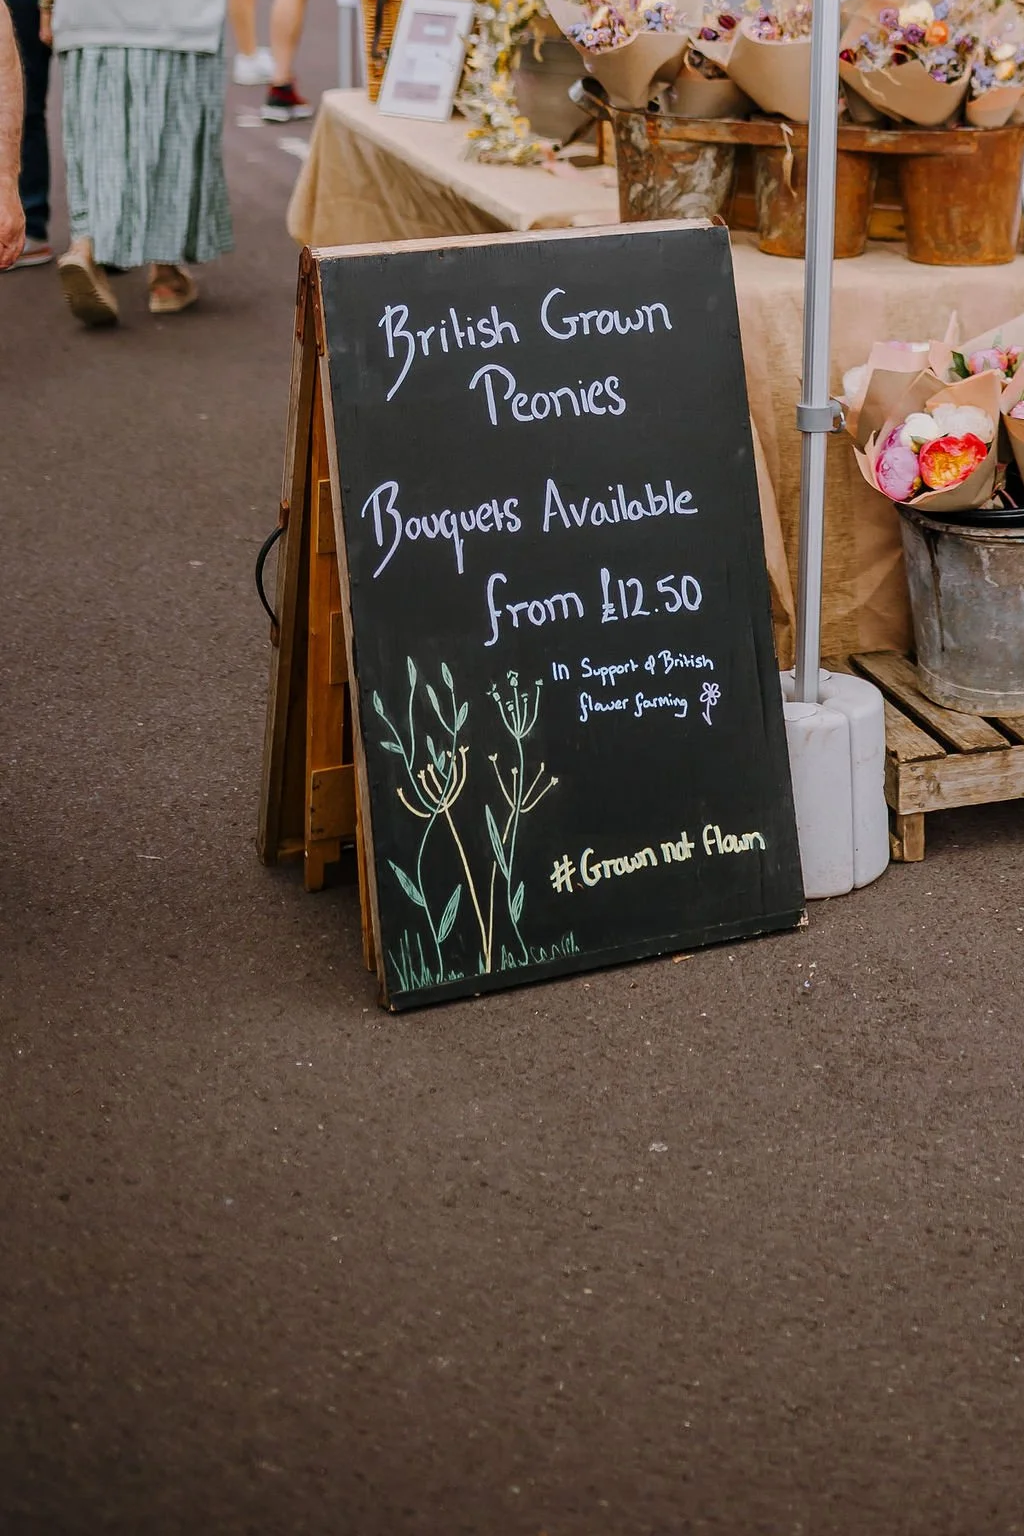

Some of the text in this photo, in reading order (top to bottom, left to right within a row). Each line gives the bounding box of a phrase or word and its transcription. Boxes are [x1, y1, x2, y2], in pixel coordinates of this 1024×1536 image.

[378, 287, 673, 402] British Grown
[469, 364, 627, 426] Peonies
[361, 478, 698, 578] Bouquets Available
[484, 567, 702, 647] from £12.50
[552, 661, 570, 681] In
[581, 657, 639, 686] Support
[658, 650, 714, 674] British
[579, 691, 689, 723] flower farming
[550, 847, 658, 893] #Grown
[661, 831, 695, 863] not
